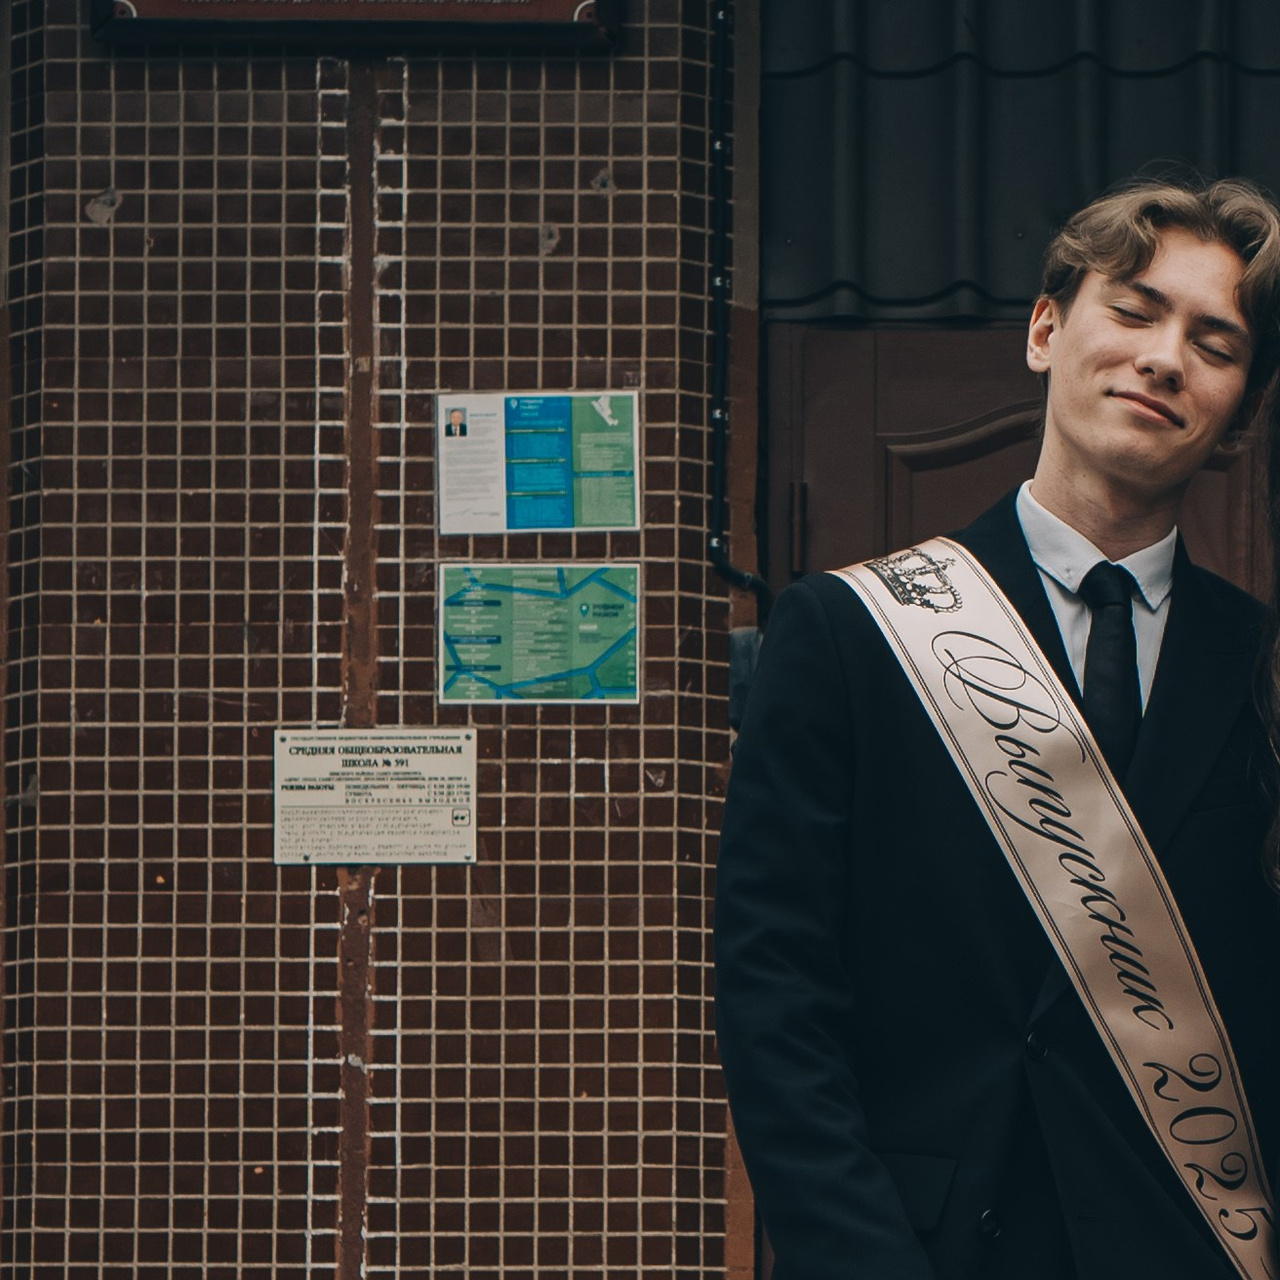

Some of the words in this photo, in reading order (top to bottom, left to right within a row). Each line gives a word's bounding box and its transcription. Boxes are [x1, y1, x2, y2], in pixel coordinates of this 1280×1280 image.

[288, 746, 336, 757] СРЕДНЯЯ
[338, 745, 463, 756] ОБЩЕОБРАЗОВАТЕЛЬНАЯ
[341, 759, 379, 768] ШКОЛА
[931, 630, 1174, 1032] Выпускник
[1142, 1053, 1275, 1241] 2025
